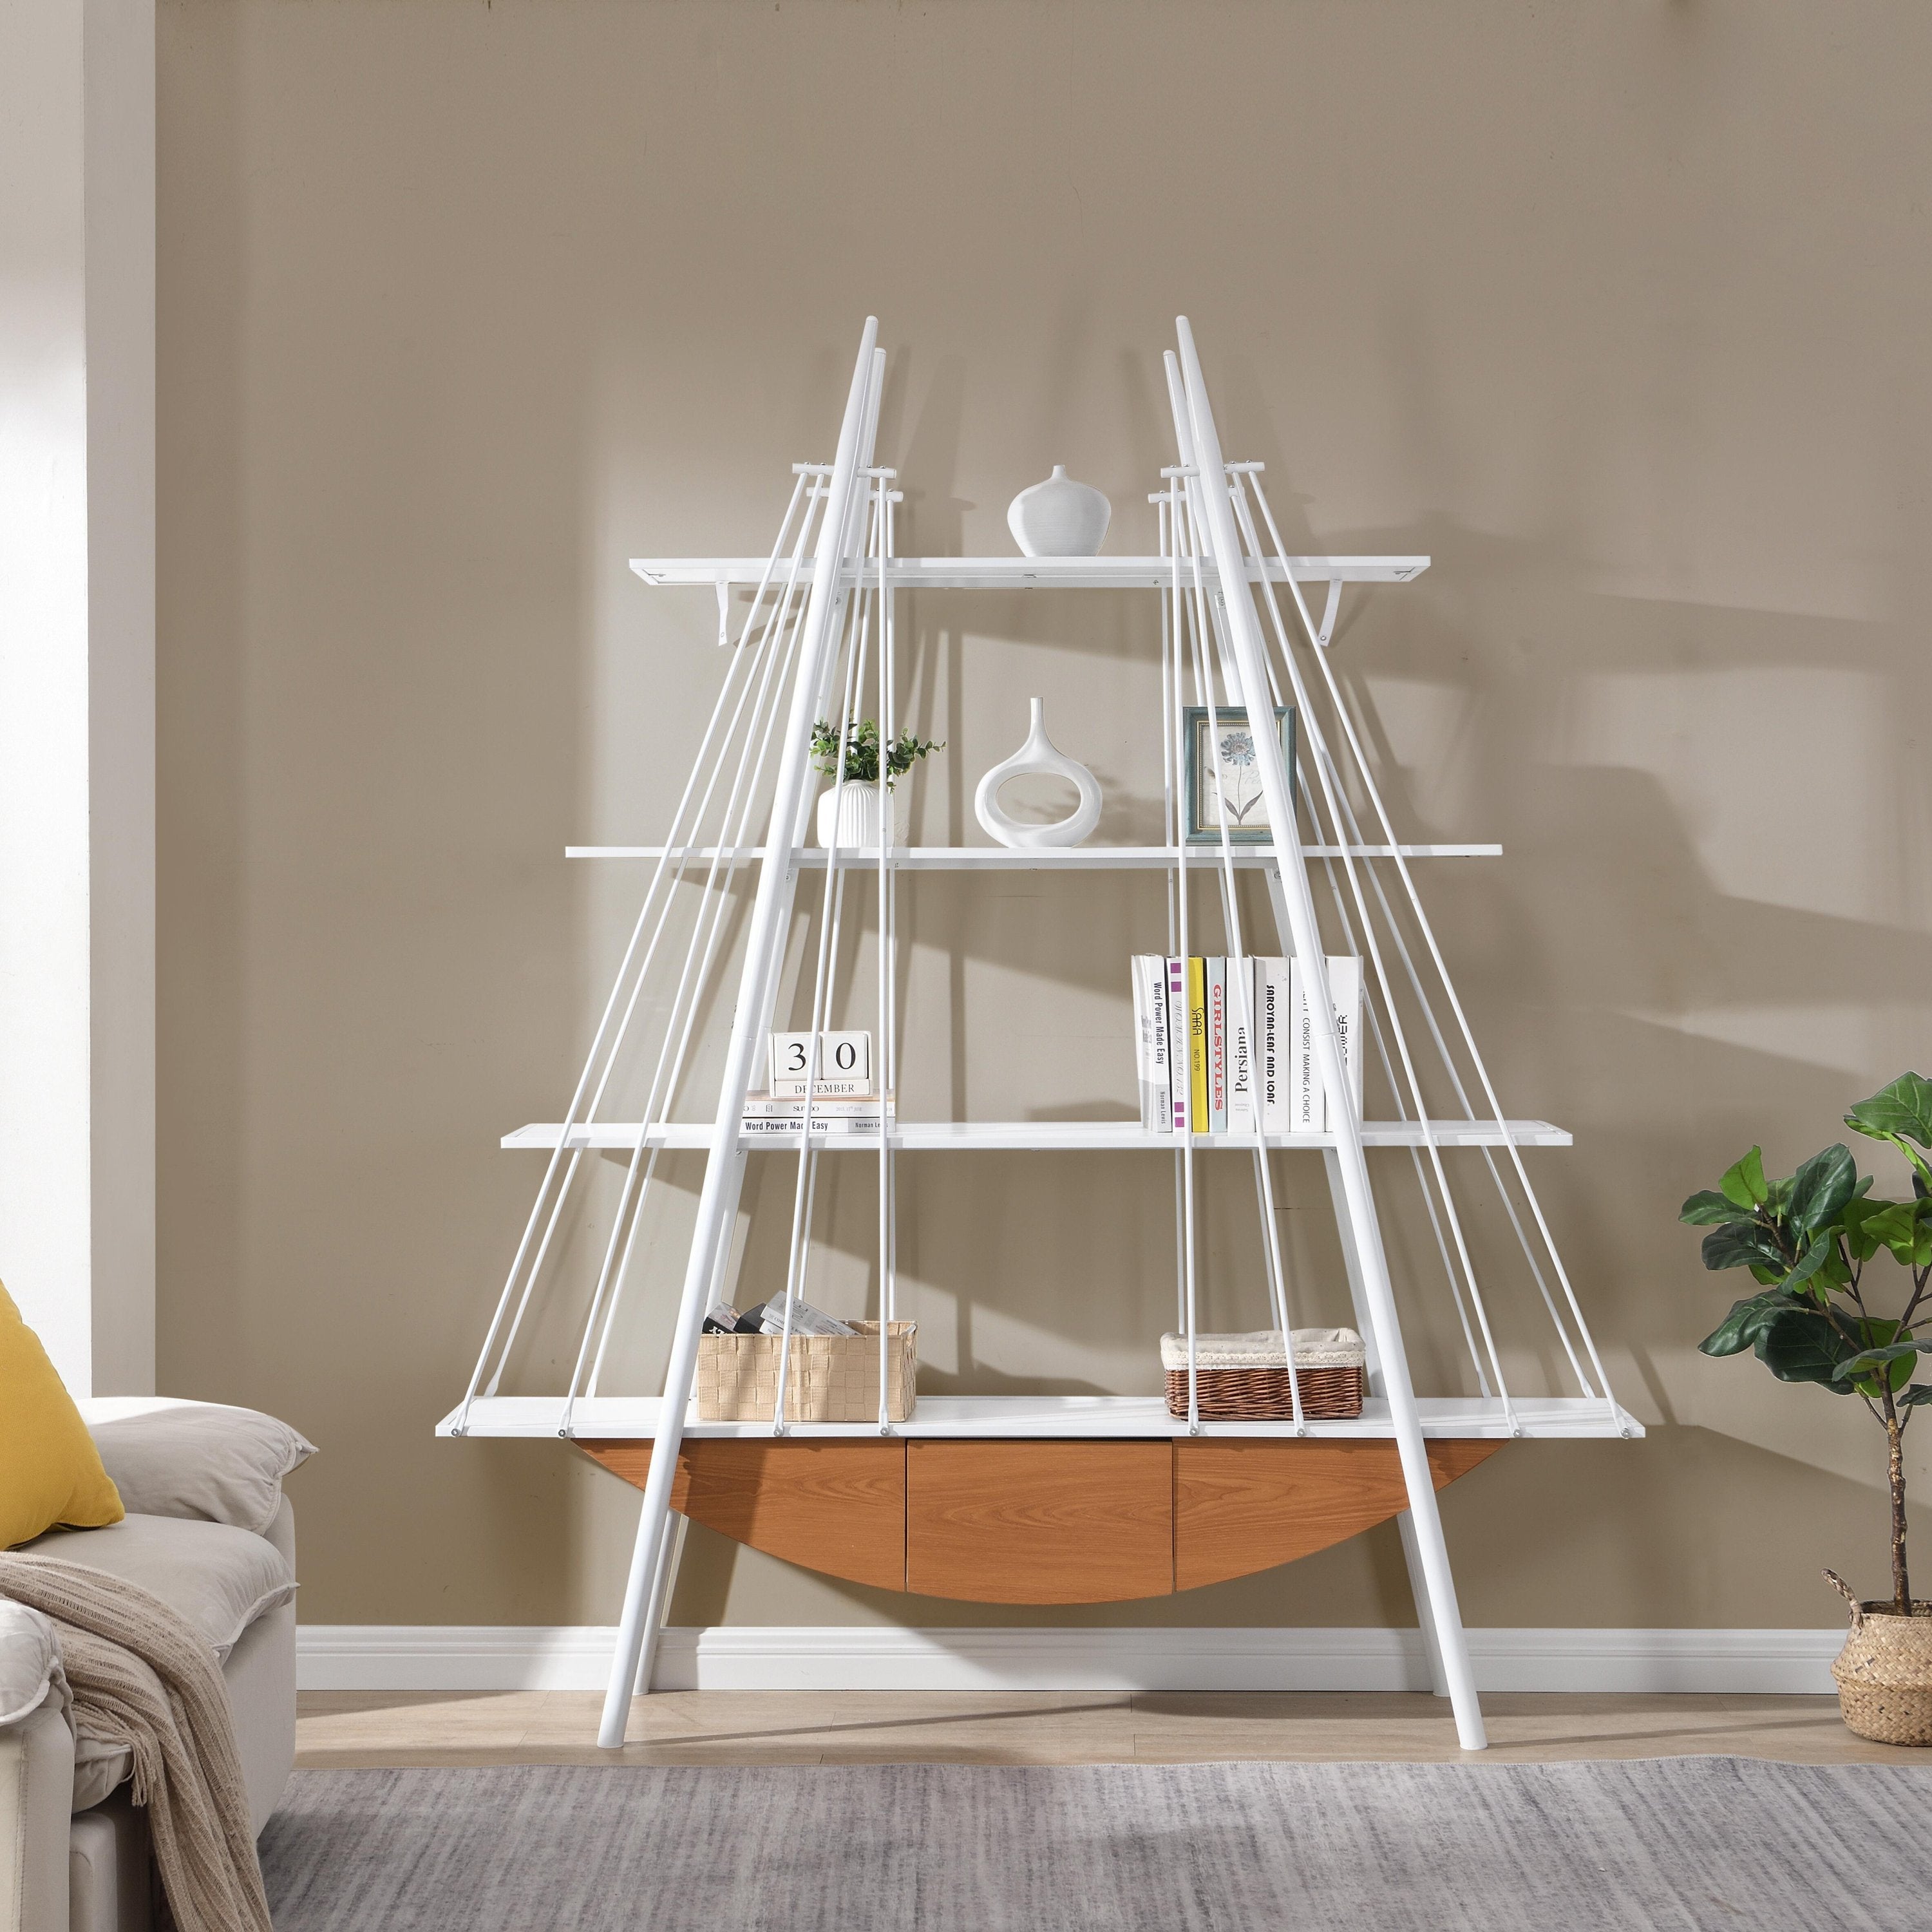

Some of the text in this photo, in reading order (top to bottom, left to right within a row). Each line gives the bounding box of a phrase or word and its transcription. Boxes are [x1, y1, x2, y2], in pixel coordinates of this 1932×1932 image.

[1153, 982, 1165, 1065] Word Power Made Easy
[1191, 1007, 1204, 1036] SARA
[1302, 1018, 1311, 1050] CONSIST
[1213, 984, 1223, 1110] GIRLSTYLES
[1235, 1027, 1248, 1093] Persiana
[1267, 1056, 1275, 1077] AND
[1302, 1054, 1311, 1085] MAKING
[795, 1084, 855, 1094] DEEMBER
[1267, 1081, 1275, 1104] LOAF
[1302, 1094, 1311, 1123] CHOICE
[745, 1122, 763, 1131] Word
[766, 1121, 787, 1130] Power
[812, 1121, 828, 1131] Easy
